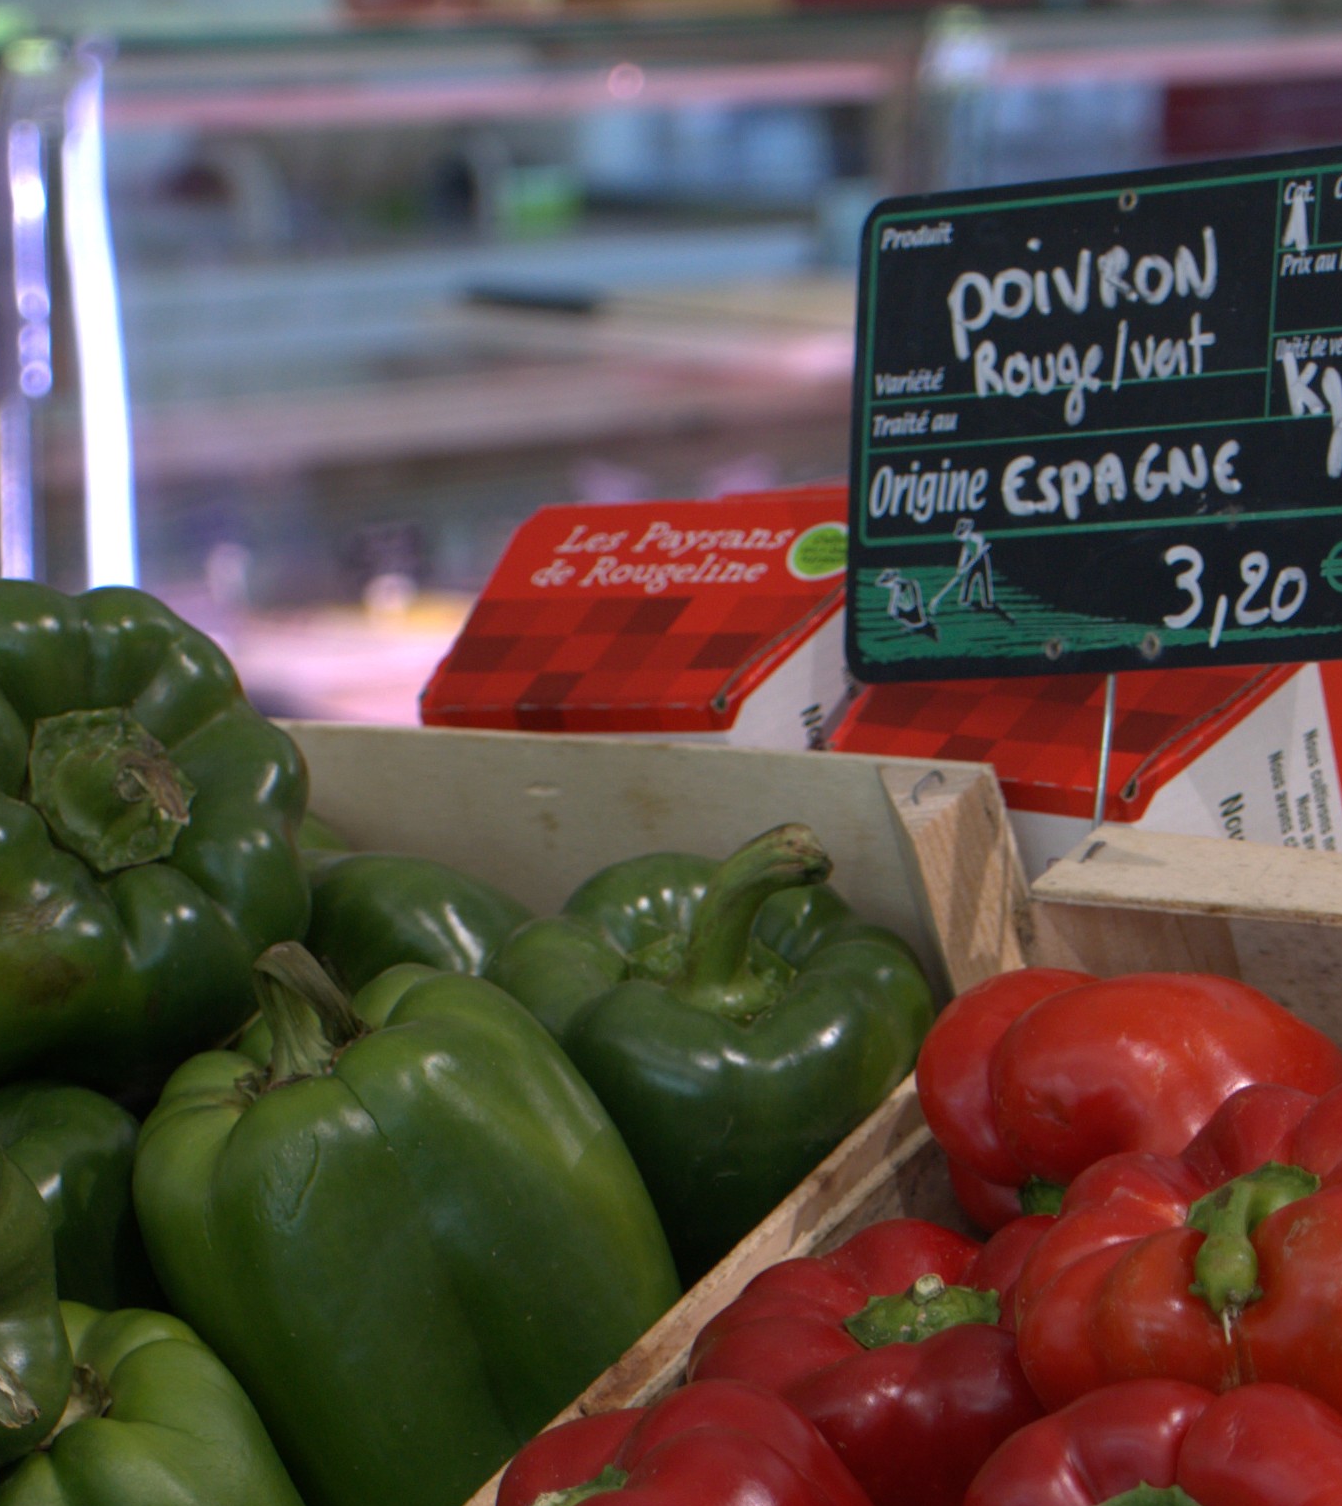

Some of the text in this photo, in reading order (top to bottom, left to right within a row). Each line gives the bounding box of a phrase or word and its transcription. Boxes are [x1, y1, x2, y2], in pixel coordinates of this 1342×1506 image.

[880, 222, 954, 251] Produit
[1280, 251, 1313, 277] Prix
[1314, 252, 1337, 273] au
[1310, 334, 1328, 358] de
[875, 367, 945, 394] Variété
[873, 410, 958, 438] Traité au
[868, 440, 1242, 524] Origine ESPAGNE
[553, 524, 629, 554] Les
[630, 521, 796, 558] Paysans
[530, 554, 769, 594] de Rougeline
[1163, 544, 1308, 648] 3,20
